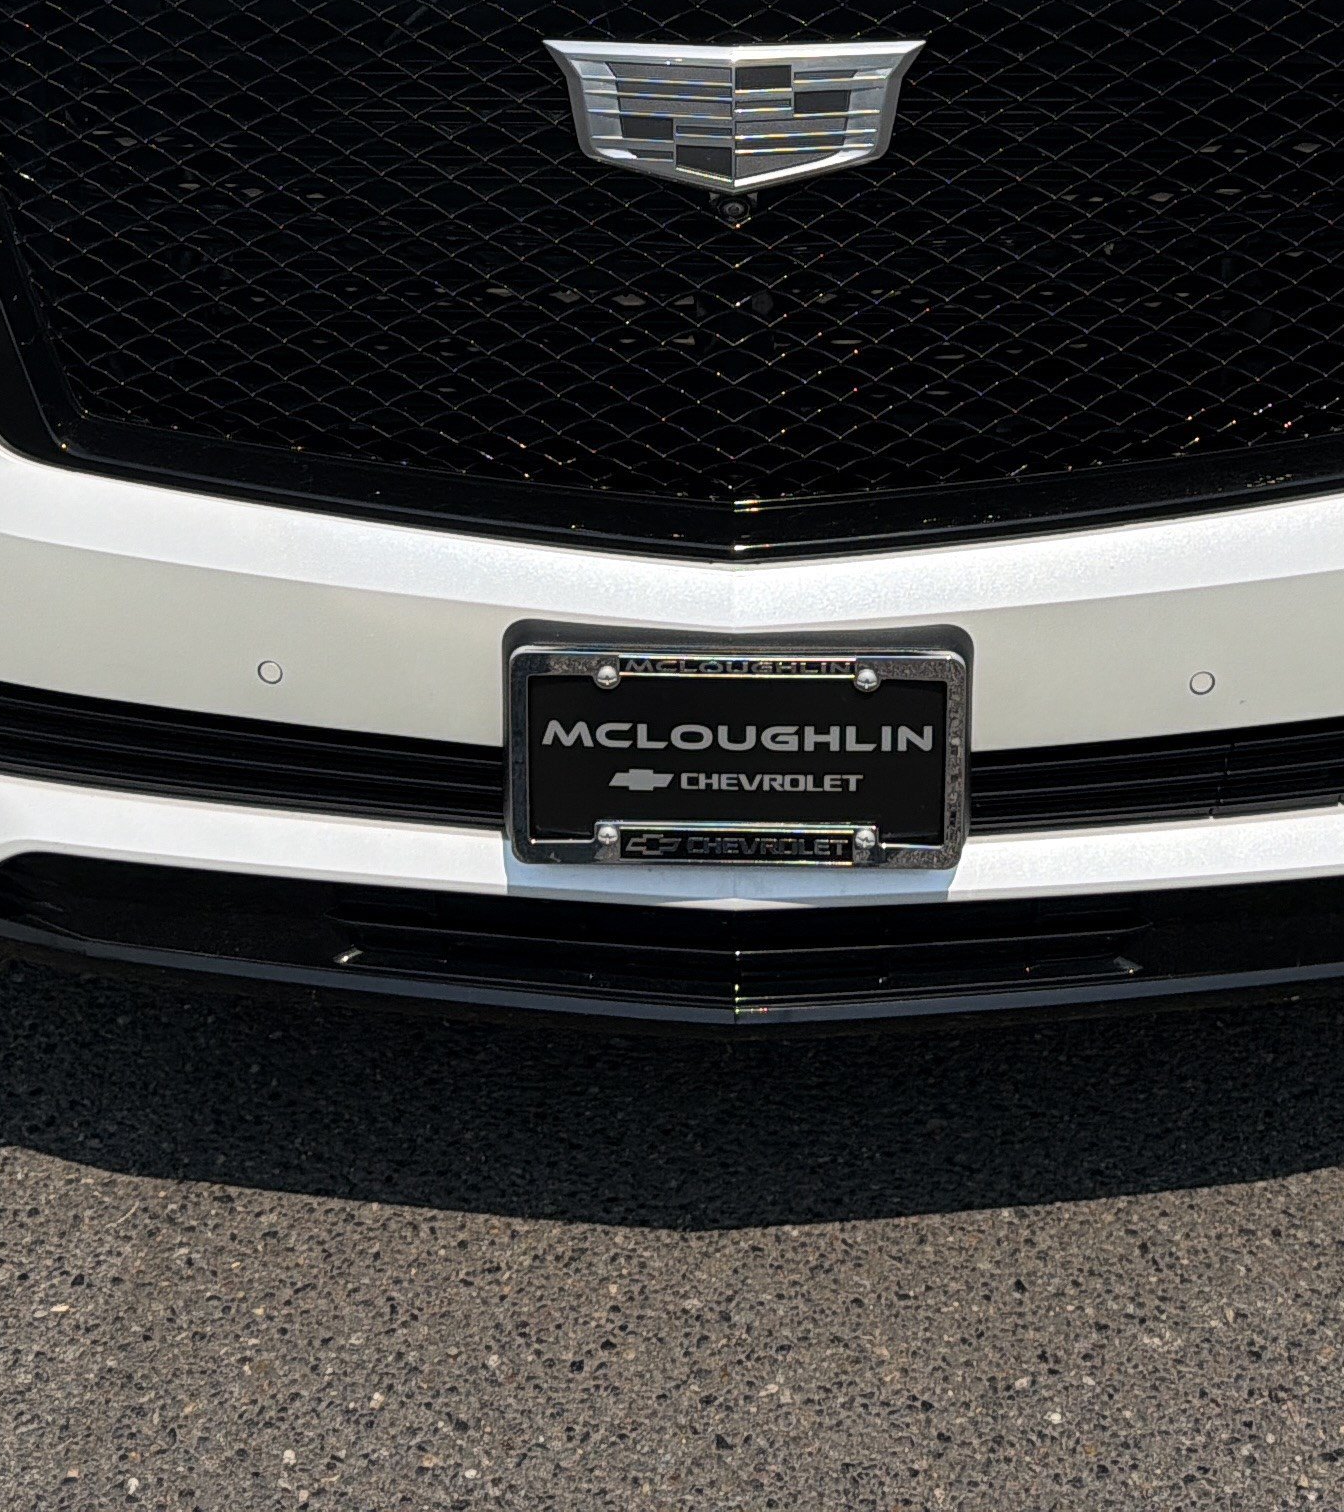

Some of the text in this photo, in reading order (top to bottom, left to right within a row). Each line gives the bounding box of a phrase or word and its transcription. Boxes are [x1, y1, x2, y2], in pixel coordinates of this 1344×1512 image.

[625, 659, 851, 674] MCLOUGHLIN
[541, 719, 933, 752] MCLOUGHLIN
[680, 772, 864, 792] CHEVROLET
[687, 836, 850, 856] CHEVROLET
